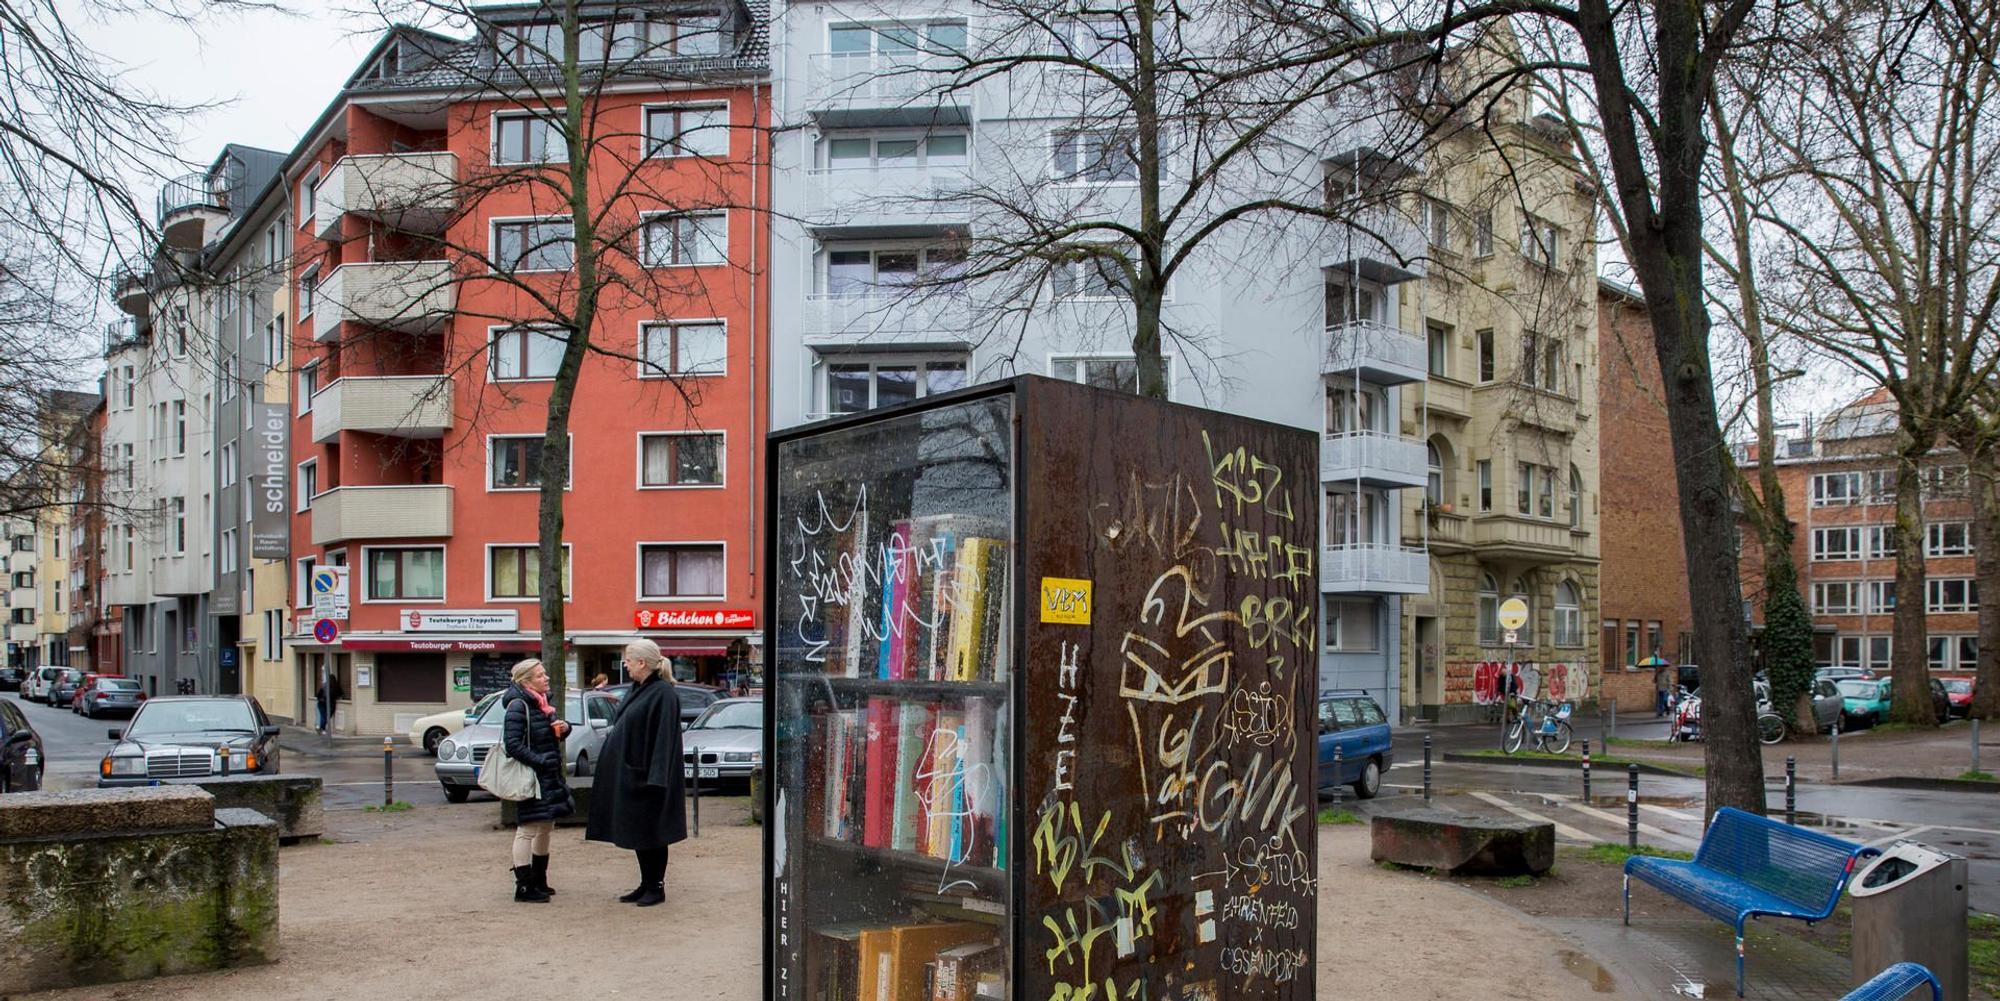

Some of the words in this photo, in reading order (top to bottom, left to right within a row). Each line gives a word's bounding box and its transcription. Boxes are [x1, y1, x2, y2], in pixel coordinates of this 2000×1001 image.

[261, 409, 284, 513] schneider
[410, 641, 452, 650] Teutoburger
[458, 641, 495, 650] Treppchen
[780, 882, 788, 946] HIER
